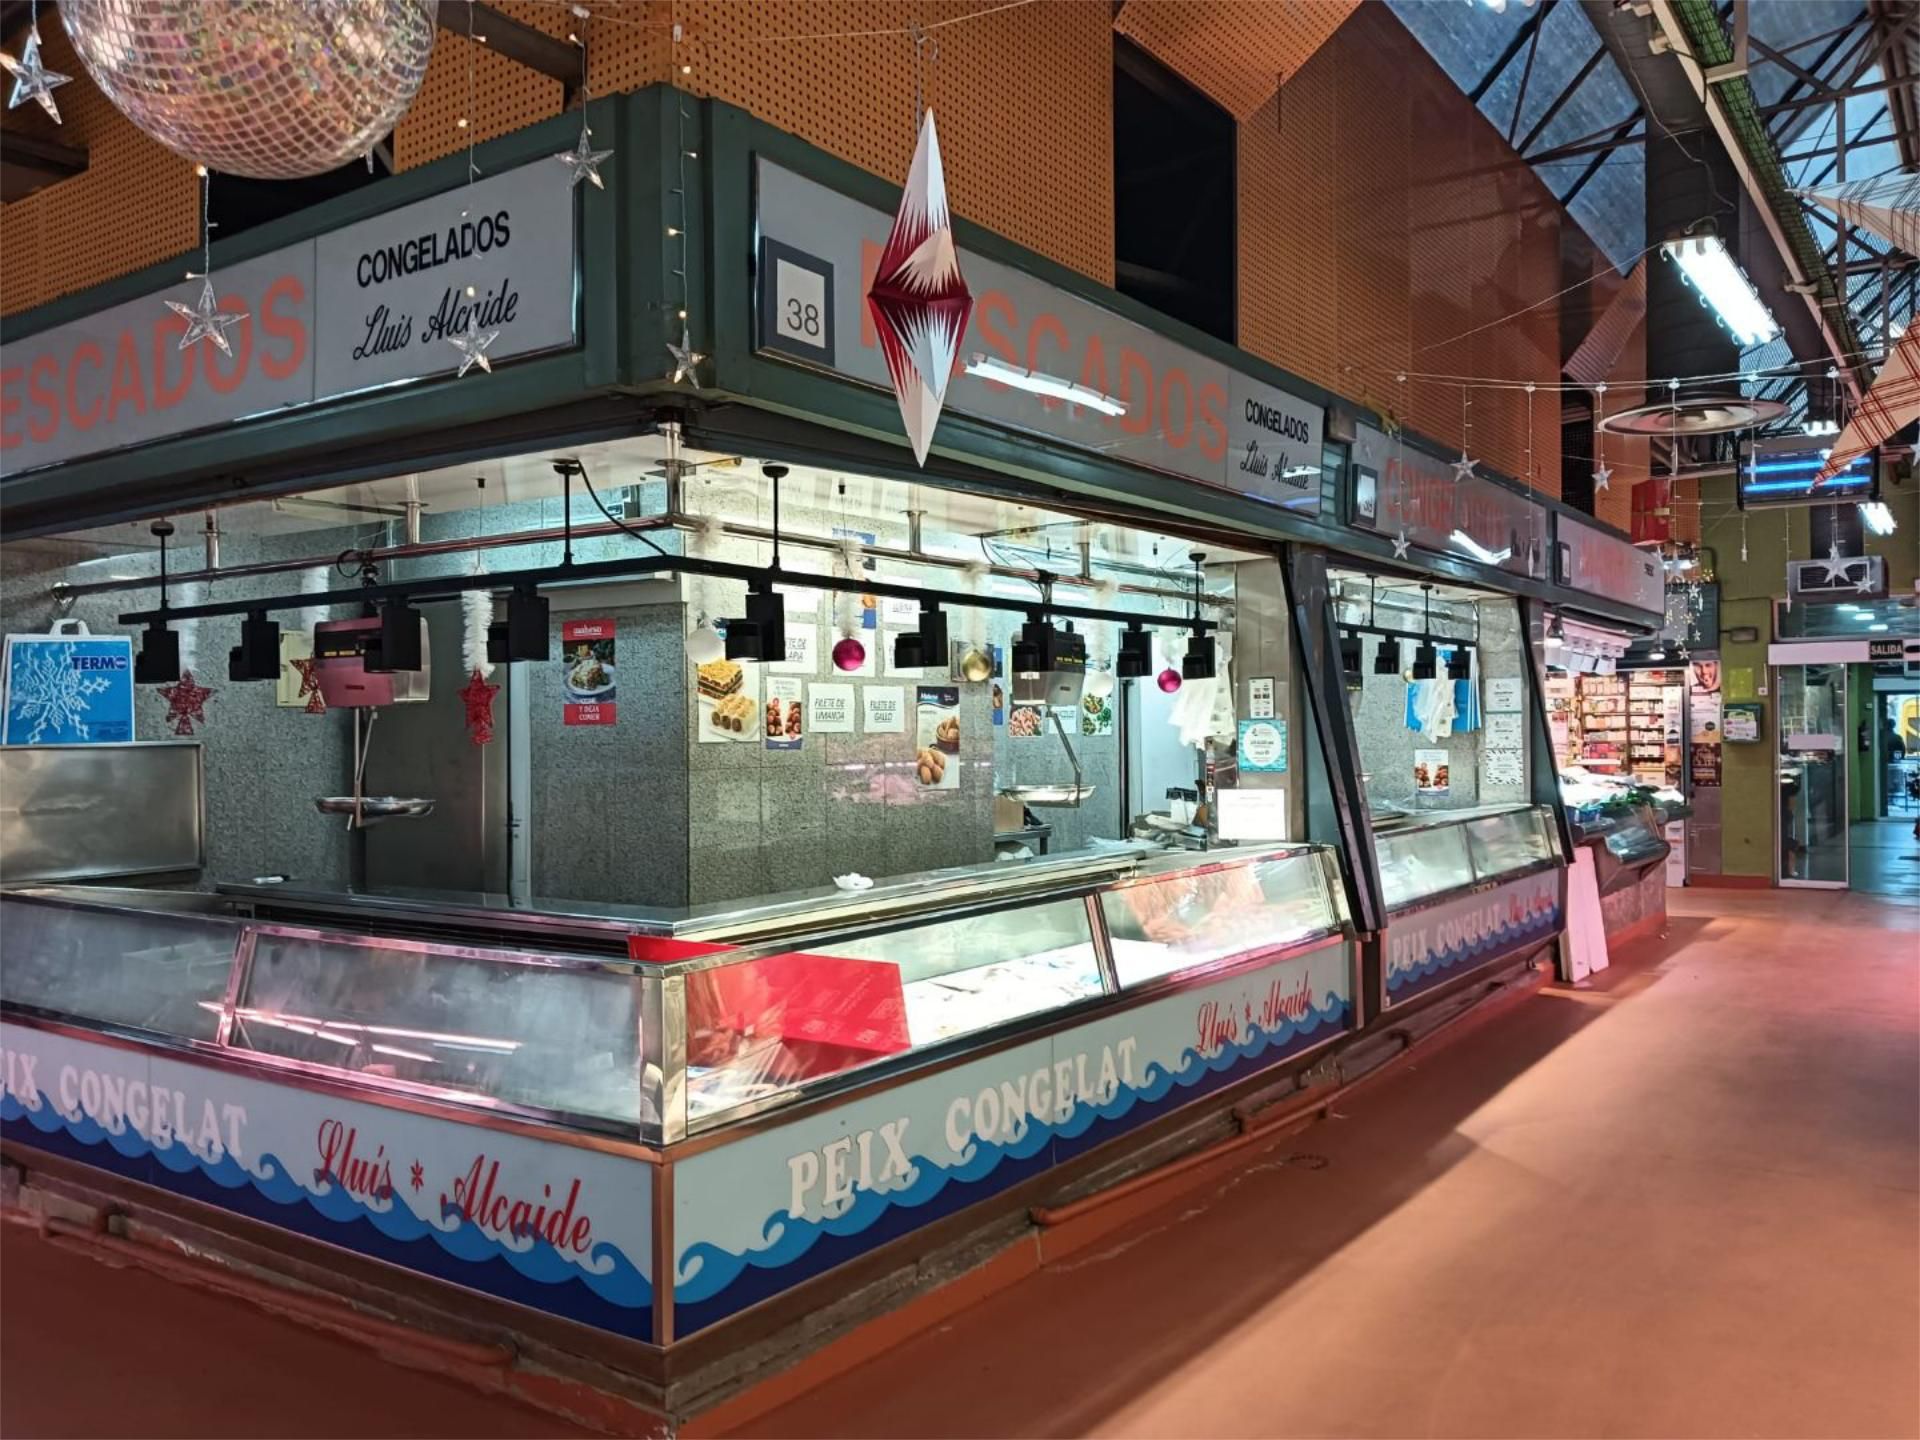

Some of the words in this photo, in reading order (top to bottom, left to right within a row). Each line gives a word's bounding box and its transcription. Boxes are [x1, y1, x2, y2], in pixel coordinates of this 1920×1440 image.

[357, 210, 510, 288] CONGELADOS
[422, 278, 518, 343] Alcaide
[787, 298, 820, 337] 38
[860, 237, 1229, 464] SCADOS
[1245, 398, 1309, 444] CONGELADOS
[71, 656, 128, 671] TERMO
[1870, 644, 1902, 656] SALIDA
[1393, 929, 1429, 969] PEIX
[1436, 903, 1501, 957] CONGELAT
[60, 1065, 248, 1160] CONGELAT
[787, 1117, 911, 1218] PEIX
[945, 1037, 1137, 1152] CONGELAT
[440, 1154, 592, 1254] Alcaide
